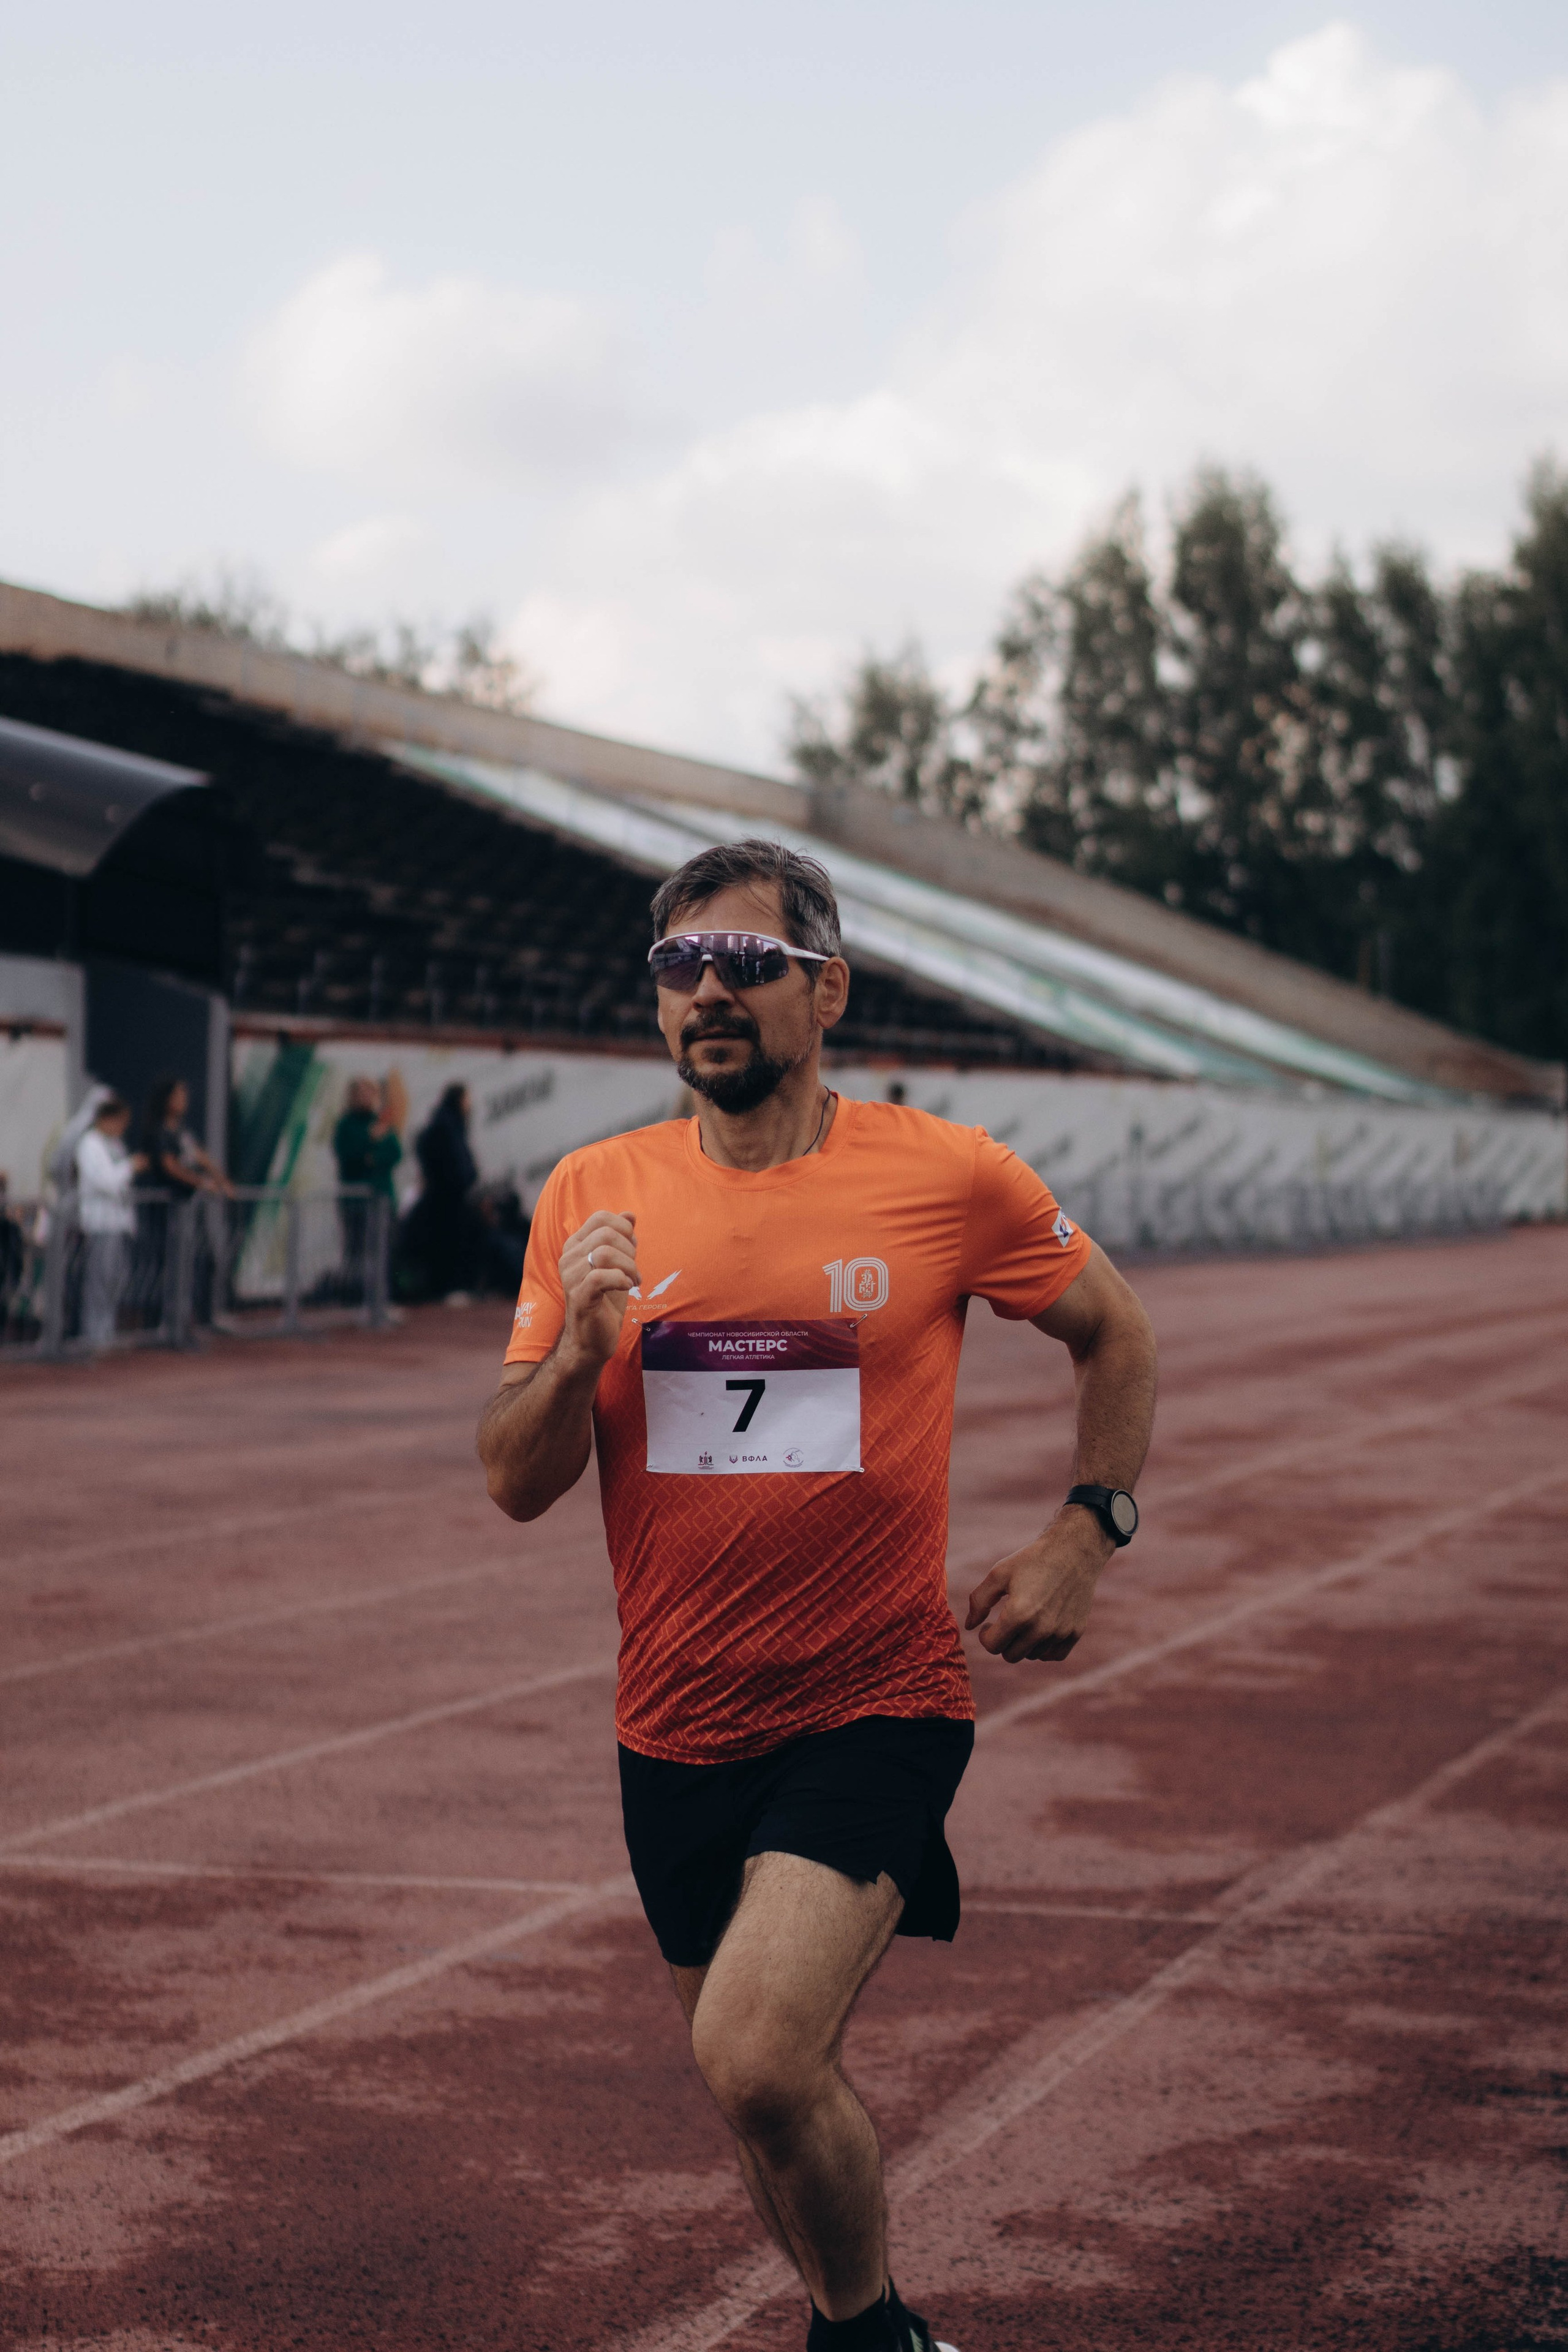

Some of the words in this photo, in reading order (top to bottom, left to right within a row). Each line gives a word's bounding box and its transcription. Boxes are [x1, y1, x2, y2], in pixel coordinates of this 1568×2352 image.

[822, 1257, 889, 1313] 10
[709, 1339, 788, 1352] МАСТЕРС
[725, 1379, 766, 1433] 7
